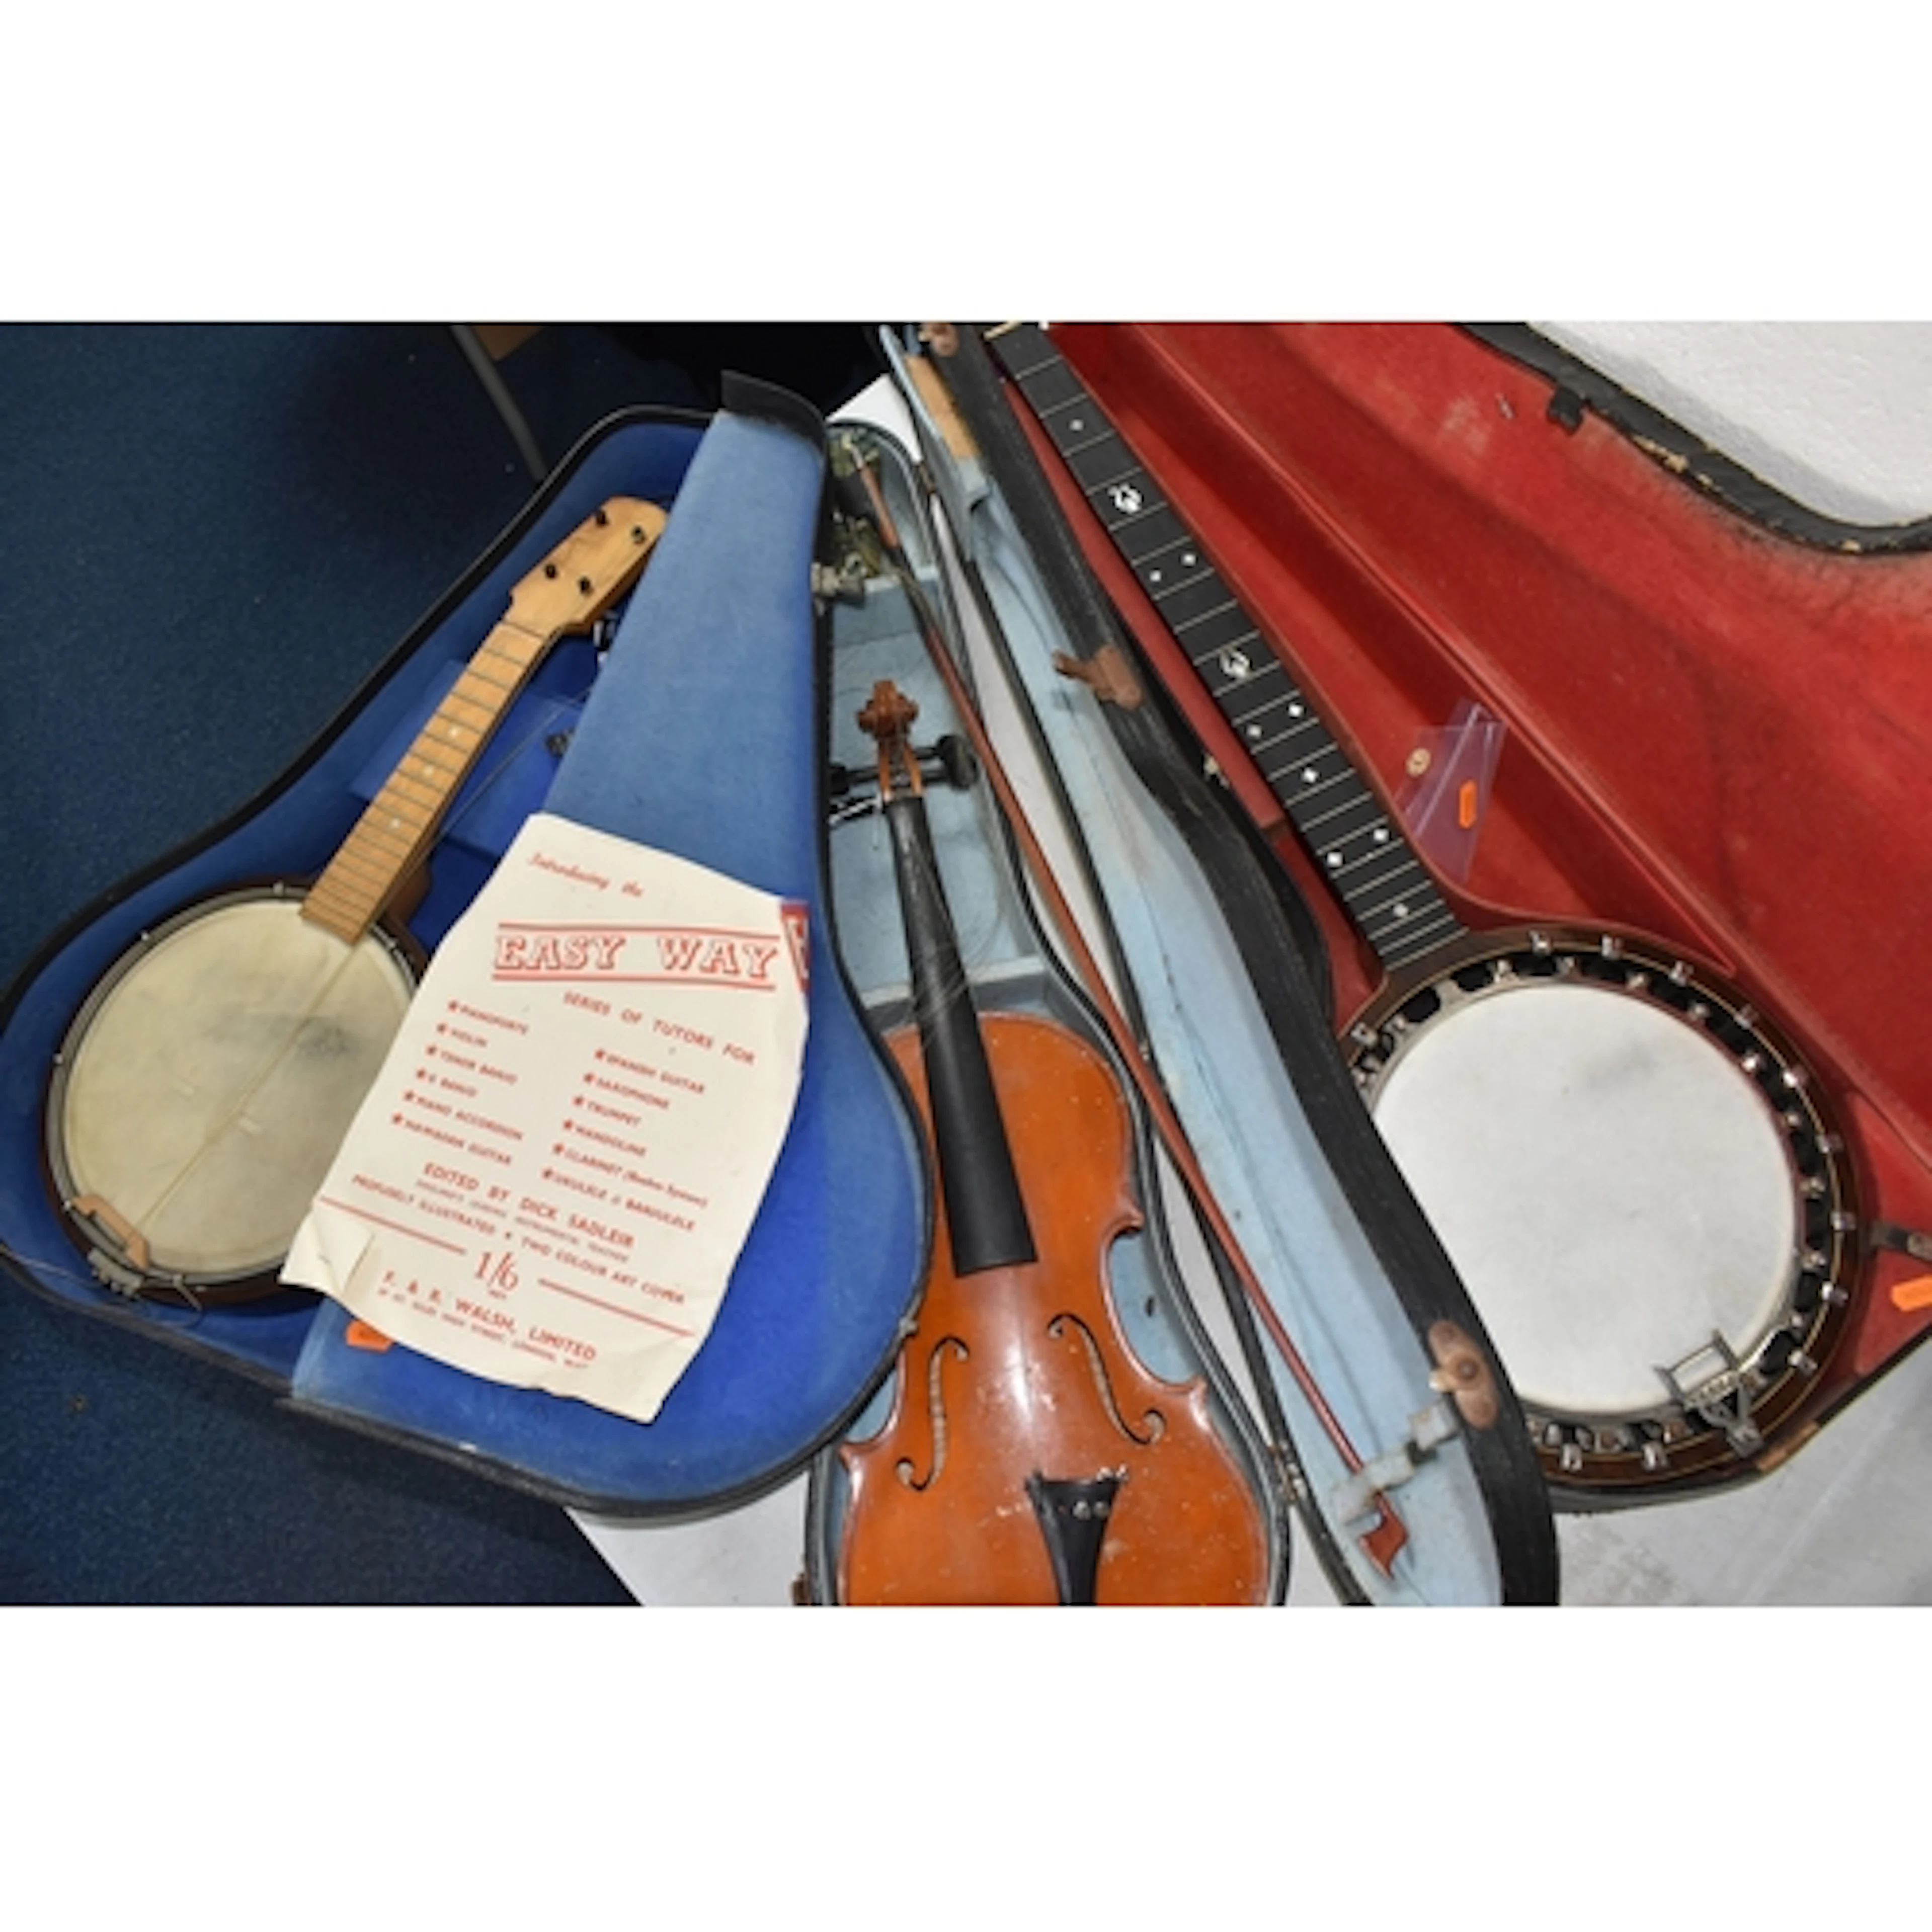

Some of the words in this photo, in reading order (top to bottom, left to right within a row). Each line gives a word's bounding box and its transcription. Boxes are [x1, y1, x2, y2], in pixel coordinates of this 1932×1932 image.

[528, 853, 609, 891] Introducing
[622, 881, 644, 898] the
[494, 935, 626, 970] EASY
[657, 935, 780, 978] WAY
[460, 1005, 529, 1035] PIANOFORTE
[564, 991, 611, 1016] SERIES
[621, 1008, 642, 1024] OF
[653, 1018, 713, 1051] TUTORS
[723, 1043, 755, 1065] FOR
[441, 1050, 475, 1070] TENOR
[479, 1065, 518, 1085] BANJO
[607, 1055, 657, 1077] SPANISH
[660, 1072, 704, 1094] GUITAR
[440, 1078, 478, 1097] BANJO
[597, 1078, 670, 1109] SAXOPHONE
[417, 1096, 452, 1115] PIANO
[587, 1100, 642, 1125] TRUMPET
[468, 1143, 511, 1167] GUITAR
[576, 1125, 647, 1157] MANDOLINE
[565, 1149, 622, 1174] CLARINET
[424, 1162, 479, 1191] EDITED
[487, 1185, 510, 1200] BY
[520, 1197, 558, 1220] DICK
[569, 1213, 634, 1248] SADLEIR
[352, 1174, 415, 1203] PROFUSELY
[419, 1200, 496, 1235] ILLUSTRATED
[522, 1236, 552, 1256] TWO
[556, 1250, 607, 1276] COLOUR
[612, 1271, 637, 1286] ART
[641, 1282, 685, 1304] COVER
[475, 1252, 519, 1290] 1/6
[529, 1327, 596, 1360] LIMITED
